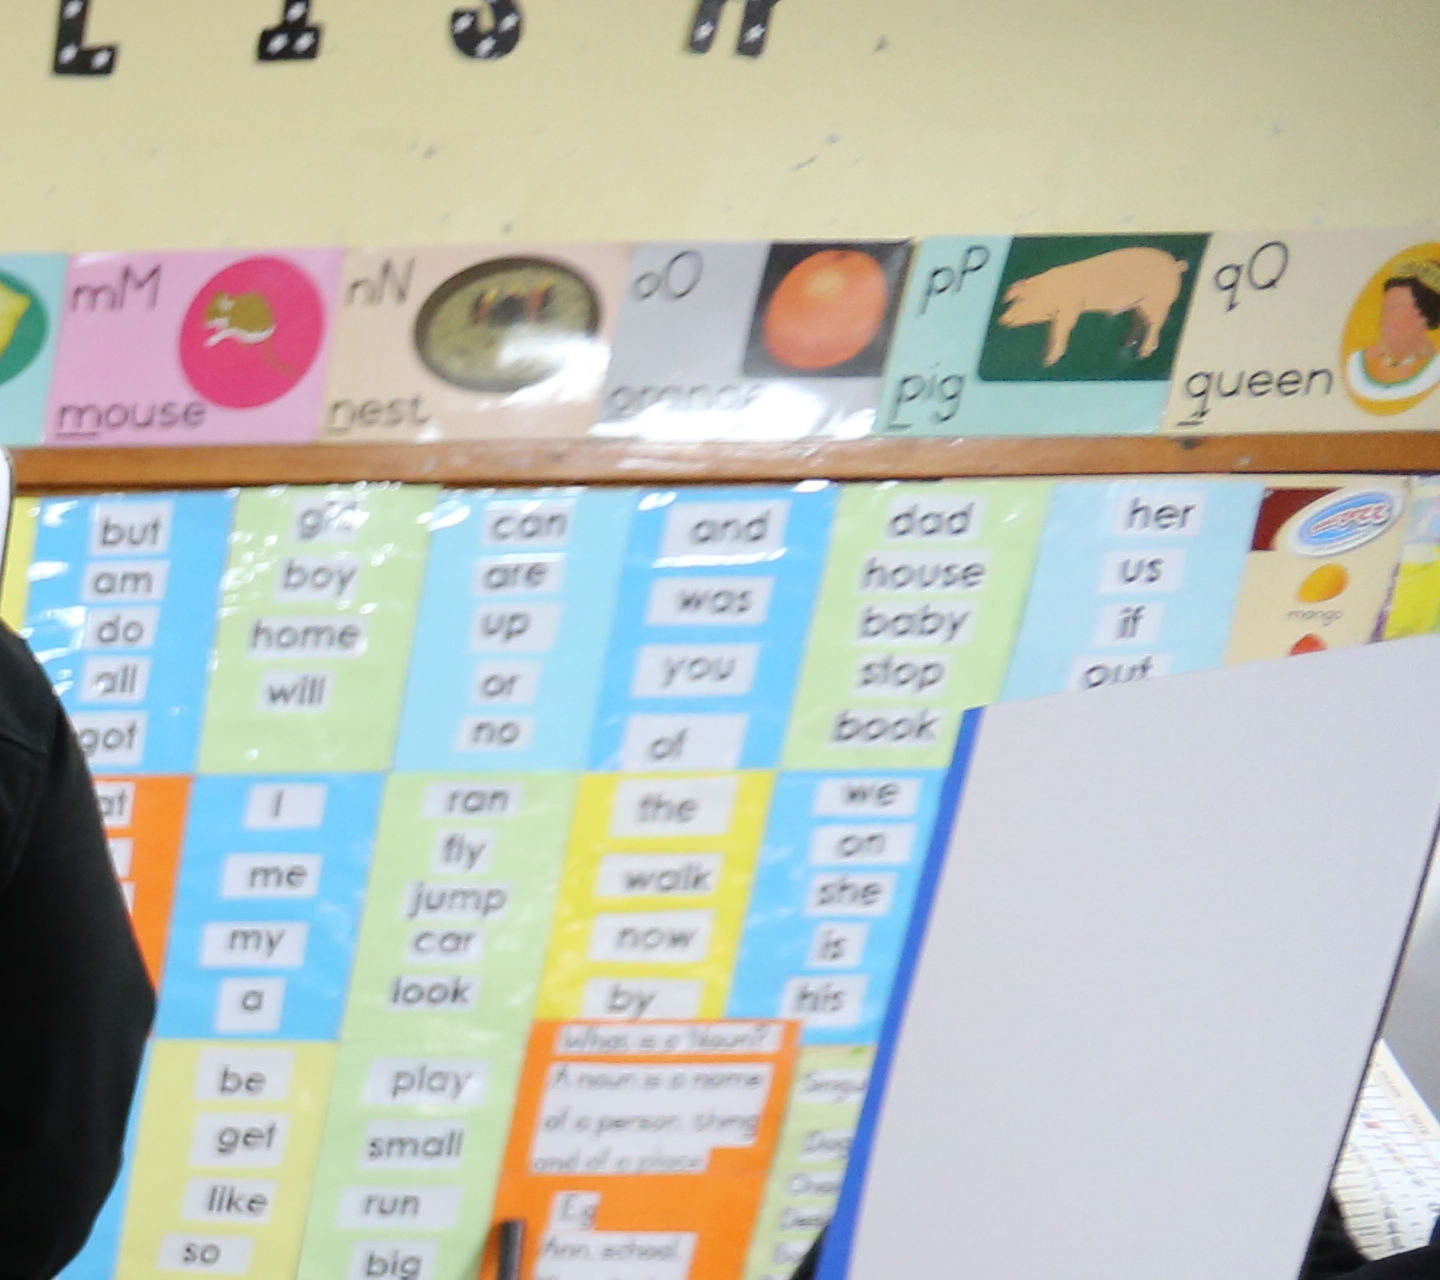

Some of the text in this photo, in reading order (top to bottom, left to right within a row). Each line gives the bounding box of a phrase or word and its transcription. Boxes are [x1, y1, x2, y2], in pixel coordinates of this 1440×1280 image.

[71, 264, 162, 309] mM
[348, 257, 414, 305] nN
[919, 244, 989, 314] pP
[1215, 242, 1289, 310] qQ
[896, 363, 967, 425] pig
[1186, 365, 1332, 418] queen
[57, 398, 208, 432] mouse
[329, 395, 430, 429] nest
[493, 514, 567, 541] can
[690, 508, 770, 545] and
[889, 502, 975, 537] dad
[1126, 497, 1197, 531] her
[101, 518, 162, 545] but
[94, 570, 153, 594] am
[283, 558, 356, 597] boy
[484, 563, 547, 590] are
[859, 557, 987, 592] house
[1119, 557, 1166, 585] us
[678, 589, 752, 614] was
[97, 615, 144, 643] do
[481, 611, 530, 642] up
[857, 604, 970, 644] baby
[1116, 605, 1147, 640] if
[1286, 608, 1344, 627] mango
[252, 619, 360, 649] home
[94, 665, 138, 697] all
[481, 672, 522, 697] or
[661, 656, 737, 689] you
[859, 654, 946, 695] stop
[269, 676, 326, 706] will
[473, 721, 520, 746] no
[832, 710, 938, 744] book
[650, 727, 690, 761] of
[445, 789, 509, 812] ran
[637, 793, 699, 823] the
[844, 782, 900, 806] we
[441, 834, 486, 870] fly
[838, 833, 887, 857] on
[249, 865, 308, 889] me
[624, 865, 713, 892] walk
[816, 876, 883, 907] she
[407, 881, 507, 919] jump
[229, 927, 286, 957] my
[413, 930, 476, 952] car
[616, 924, 697, 950] now
[818, 929, 848, 961] is
[391, 976, 470, 1005] look
[607, 984, 660, 1018] by
[794, 984, 847, 1012] his
[219, 1065, 267, 1095] be
[392, 1065, 473, 1101] play
[216, 1123, 278, 1155] get
[368, 1130, 465, 1159] small
[207, 1184, 269, 1214] like
[363, 1192, 421, 1217] run
[182, 1242, 221, 1265] so
